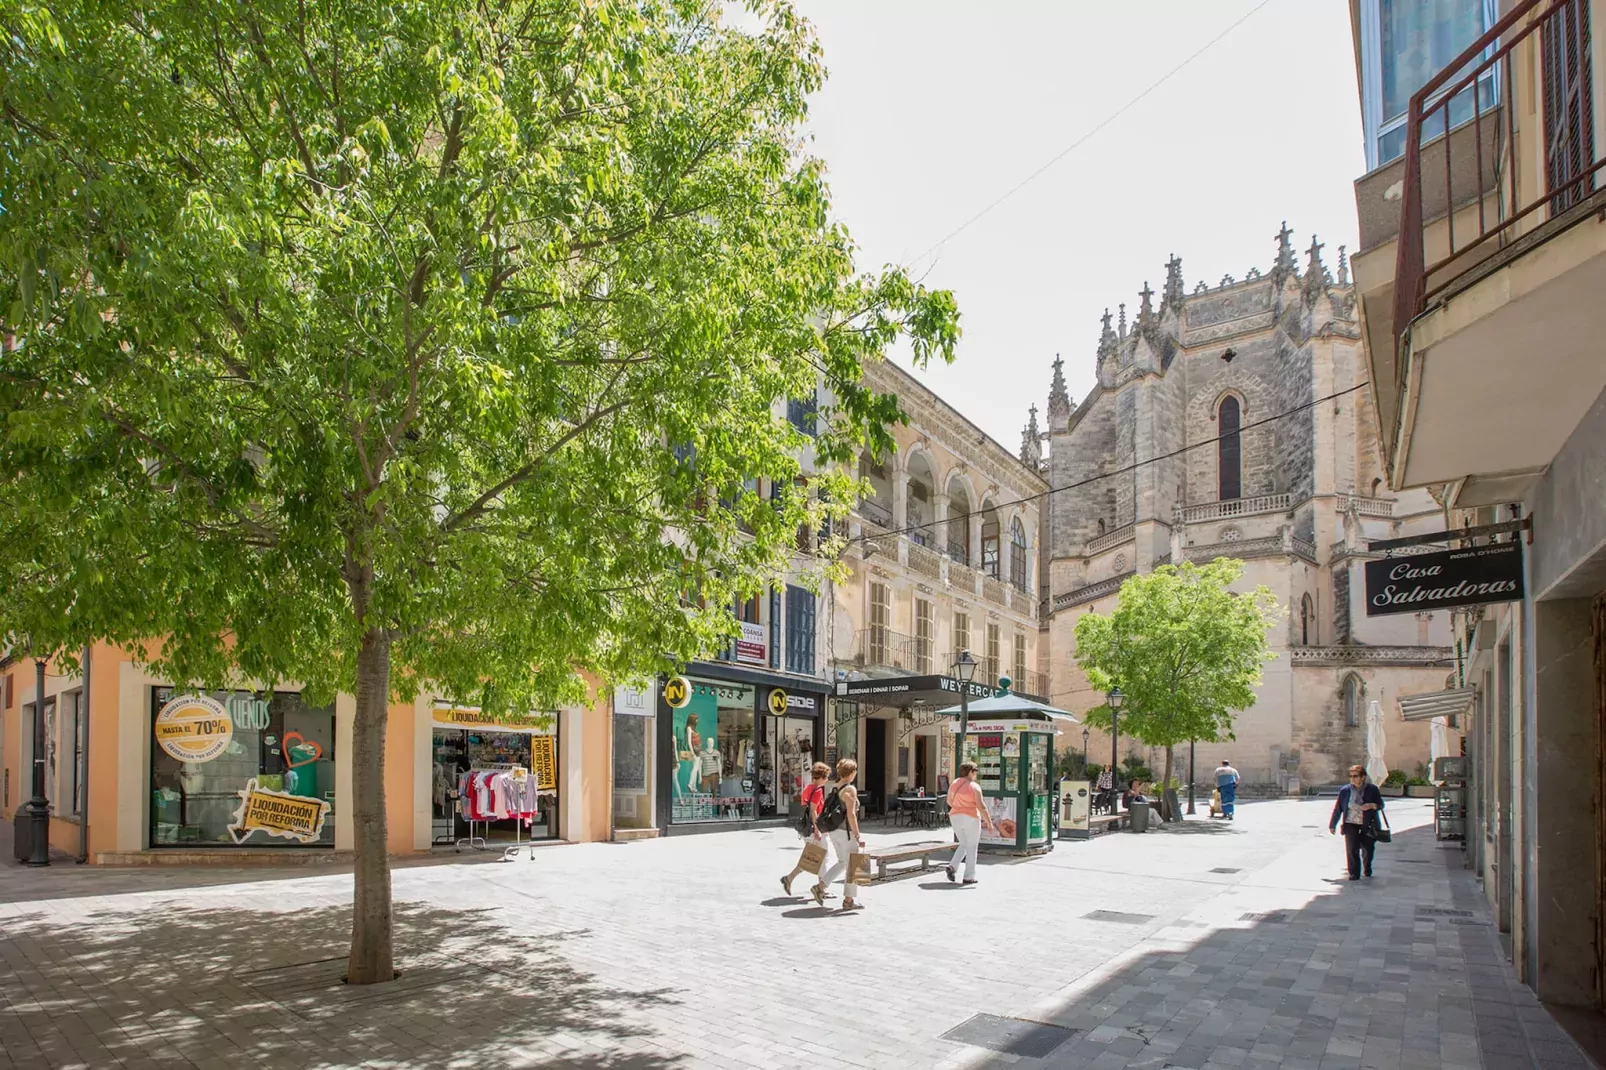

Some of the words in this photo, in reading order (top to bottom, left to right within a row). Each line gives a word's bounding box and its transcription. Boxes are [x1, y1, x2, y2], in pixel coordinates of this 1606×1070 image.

[1389, 563, 1443, 581] Casa
[1372, 578, 1516, 607] Salvadoras
[162, 726, 183, 735] HASTA
[184, 725, 191, 733] EL
[194, 719, 226, 736] 70%
[252, 798, 313, 819] LIQUIDACIÓN
[250, 809, 268, 821] POR
[268, 814, 310, 829] REFORMA
